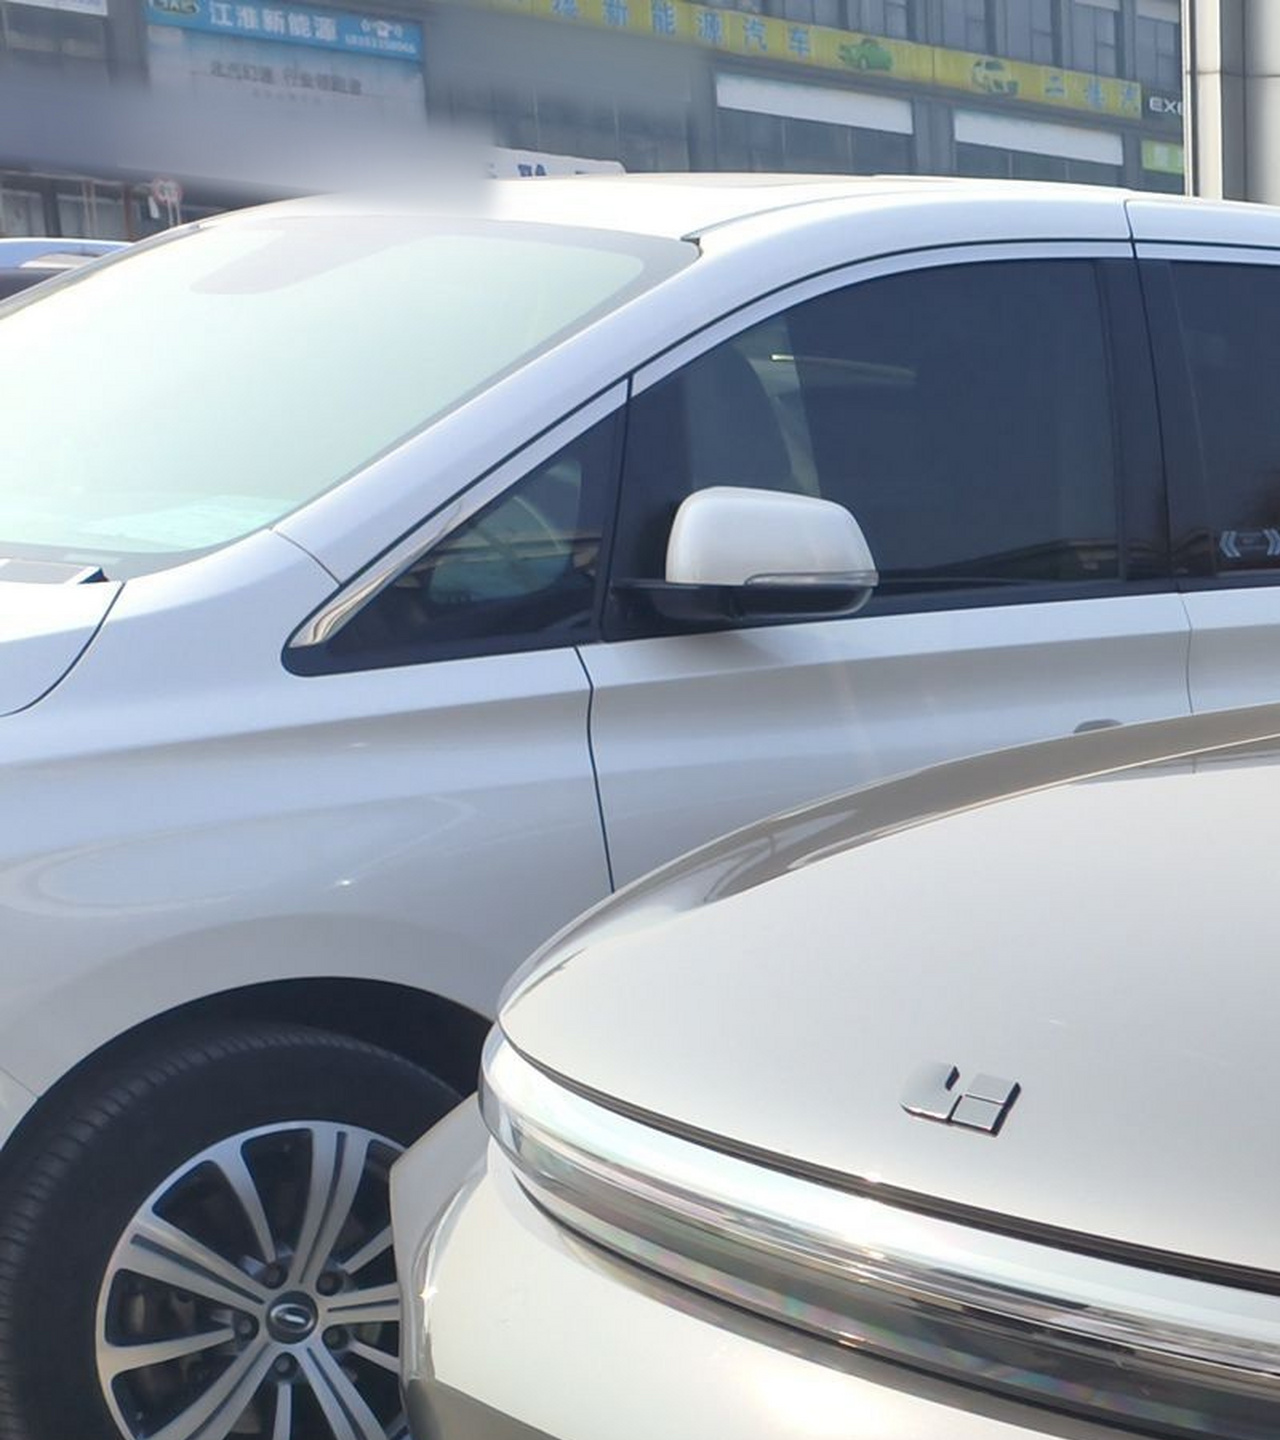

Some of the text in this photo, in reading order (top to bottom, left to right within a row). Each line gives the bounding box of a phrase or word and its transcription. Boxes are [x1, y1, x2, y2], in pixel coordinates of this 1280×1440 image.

[209, 2, 339, 42] 江淮新能源
